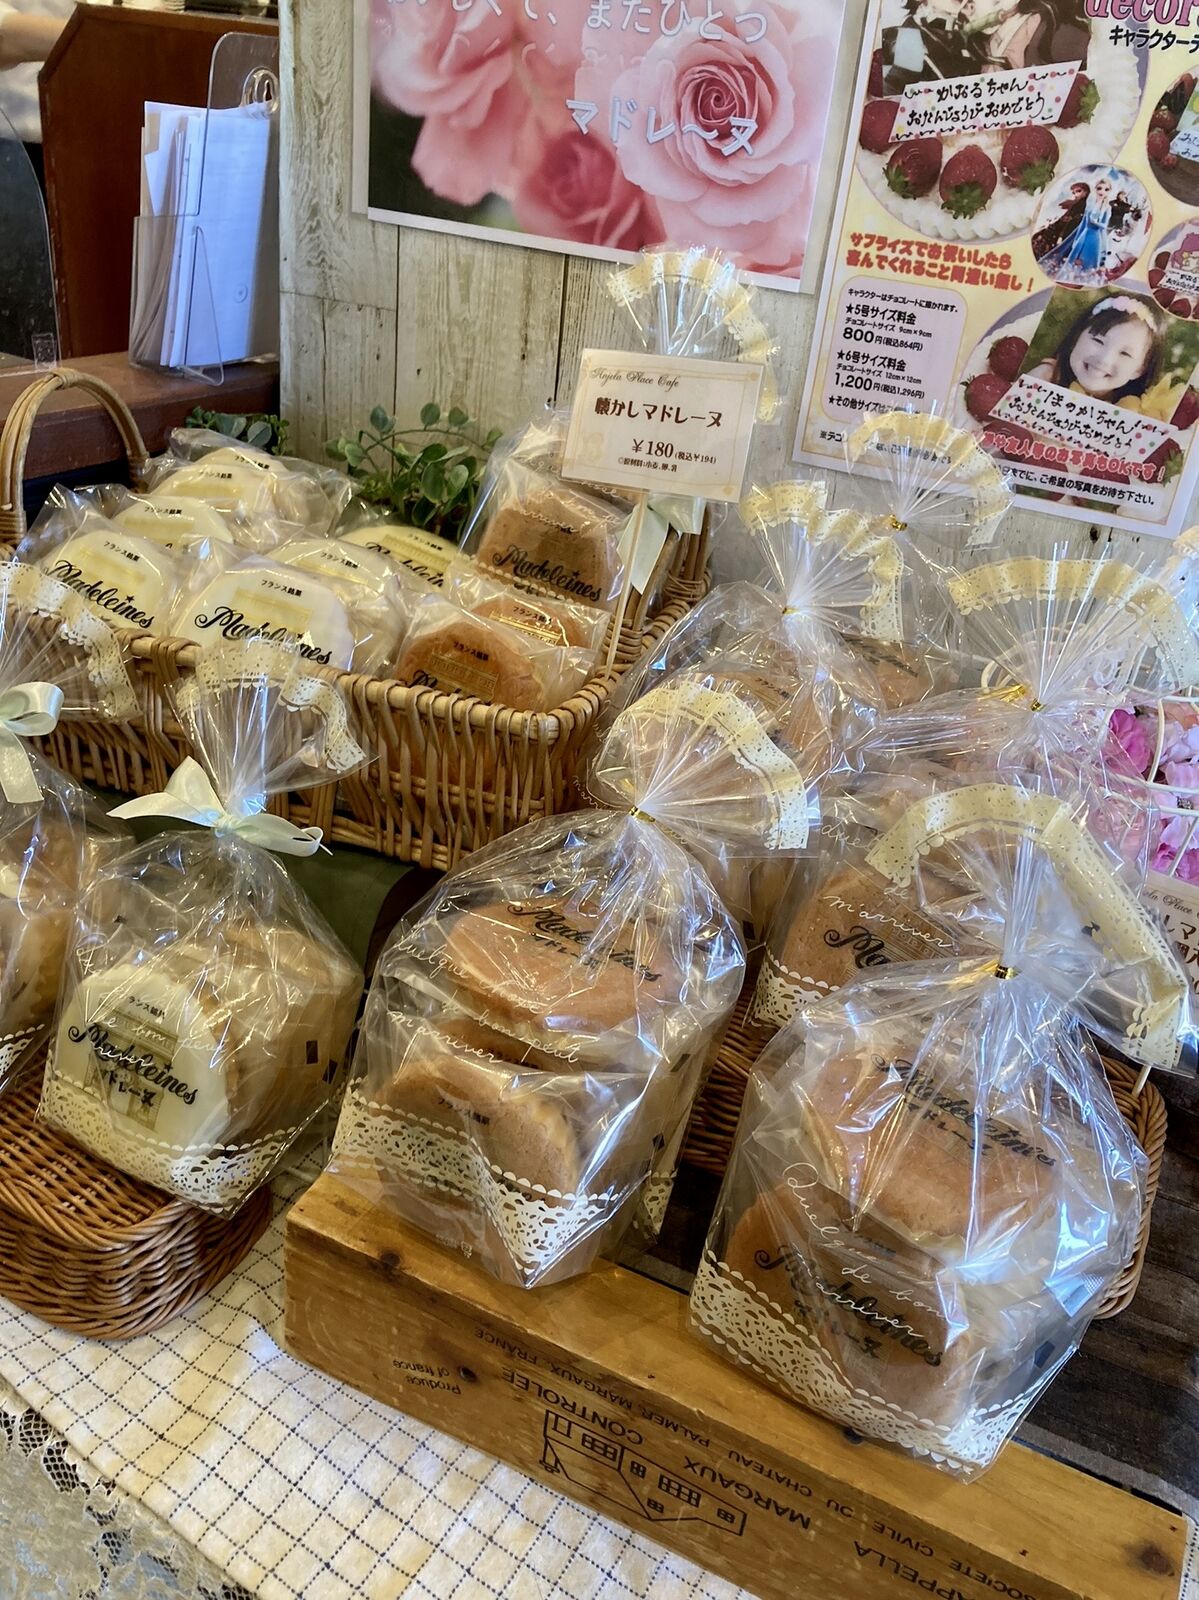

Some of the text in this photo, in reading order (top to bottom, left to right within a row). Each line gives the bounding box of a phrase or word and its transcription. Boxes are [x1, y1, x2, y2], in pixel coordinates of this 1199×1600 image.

[626, 370, 654, 385] Place
[492, 544, 602, 602] Madeleines
[475, 1326, 539, 1368] FRANCE
[684, 1455, 812, 1531] MARGAUX
[728, 1449, 813, 1498] CHATEAU
[873, 1519, 935, 1557] CIVILE
